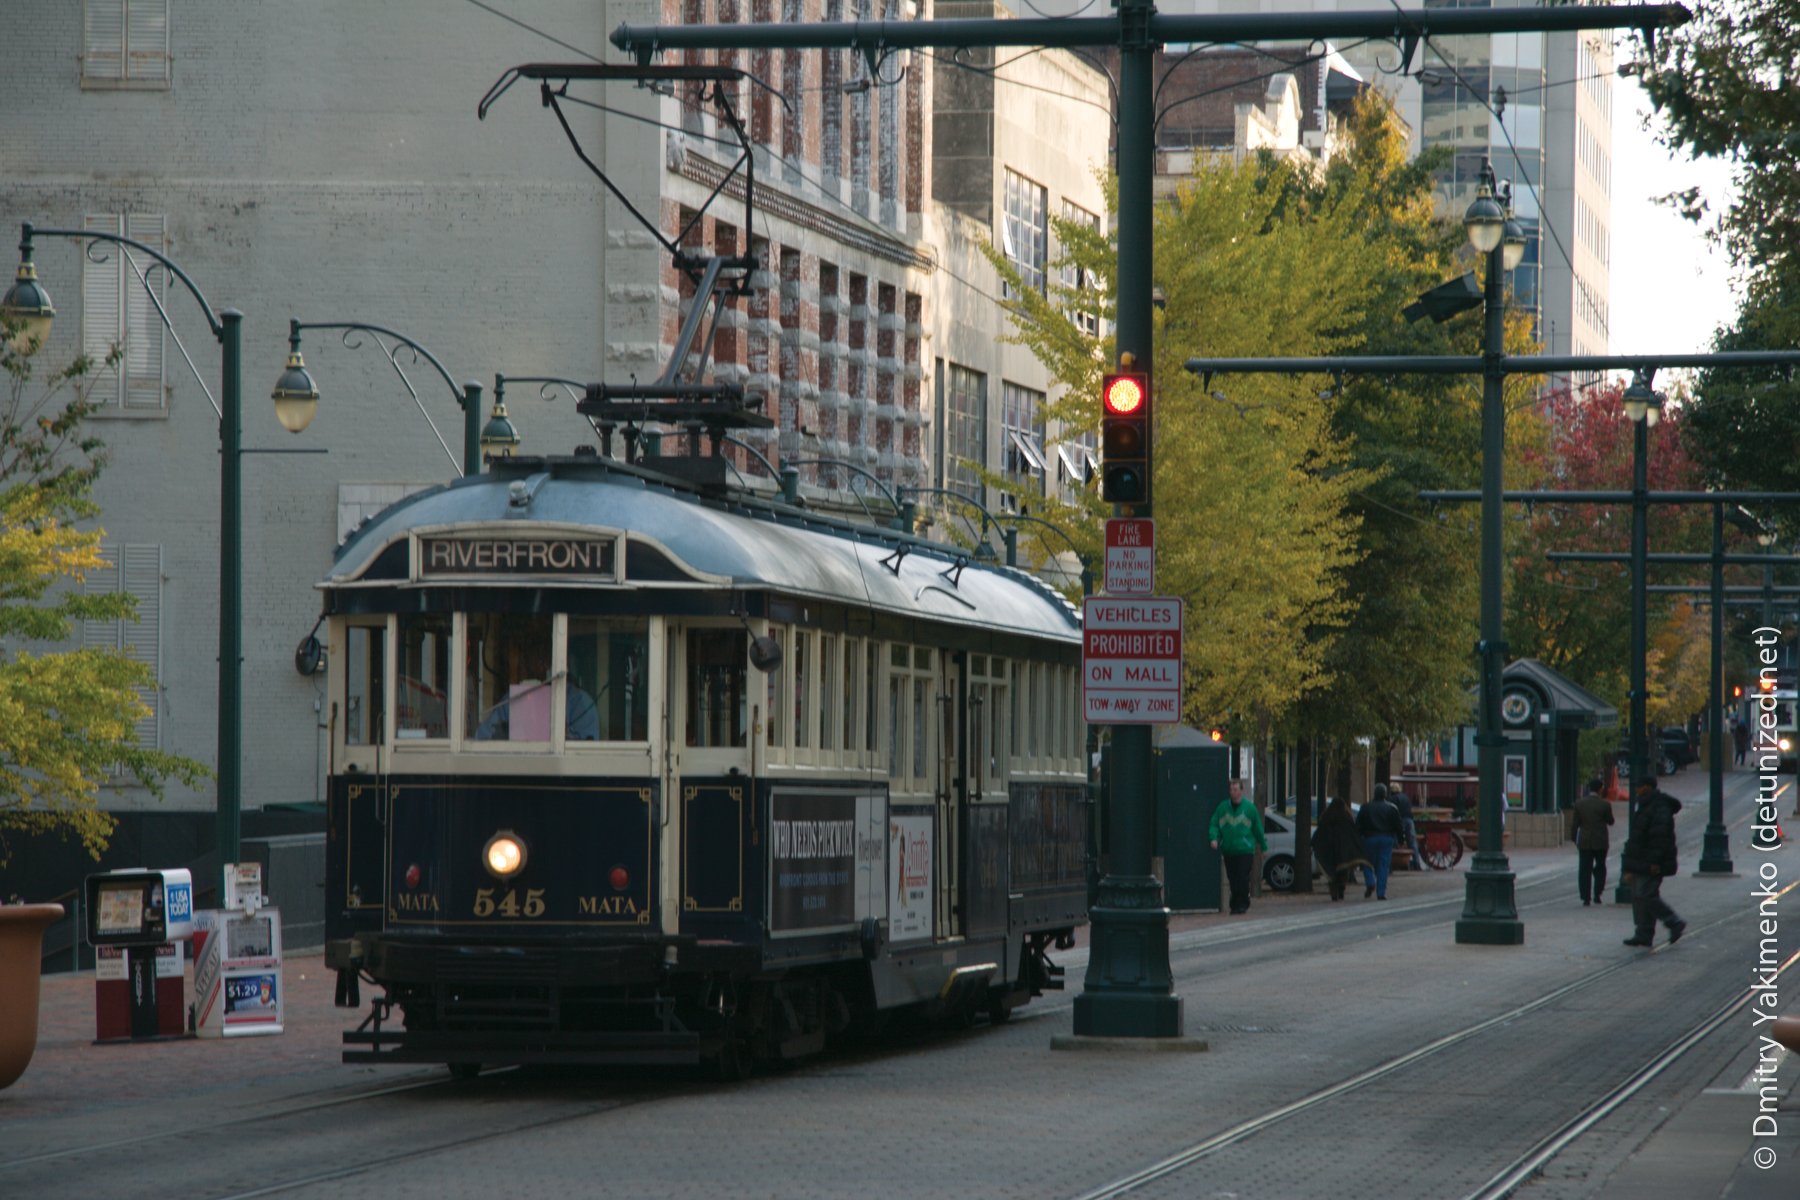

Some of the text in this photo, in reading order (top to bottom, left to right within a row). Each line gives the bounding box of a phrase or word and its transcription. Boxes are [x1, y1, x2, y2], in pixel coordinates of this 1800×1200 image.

[1119, 523, 1140, 535] FIRE
[1117, 535, 1142, 546] LANE
[431, 541, 608, 567] RIVERFRONT
[1123, 550, 1136, 560] NO
[1108, 560, 1150, 571] PARKING
[1108, 577, 1150, 588] STANDING
[1095, 607, 1171, 623] VEHICLES
[1090, 635, 1174, 655] PROHIBITED
[1091, 665, 1173, 683] ON MALL
[1147, 699, 1175, 712] ZONE
[773, 820, 791, 859] WHO
[791, 820, 818, 859] NEEDS
[818, 820, 854, 858] PICKWICK
[175, 889, 188, 905] USA
[397, 893, 440, 913] MATA
[473, 888, 546, 917] 545
[578, 896, 638, 914] MATA
[170, 902, 189, 917] TODAY
